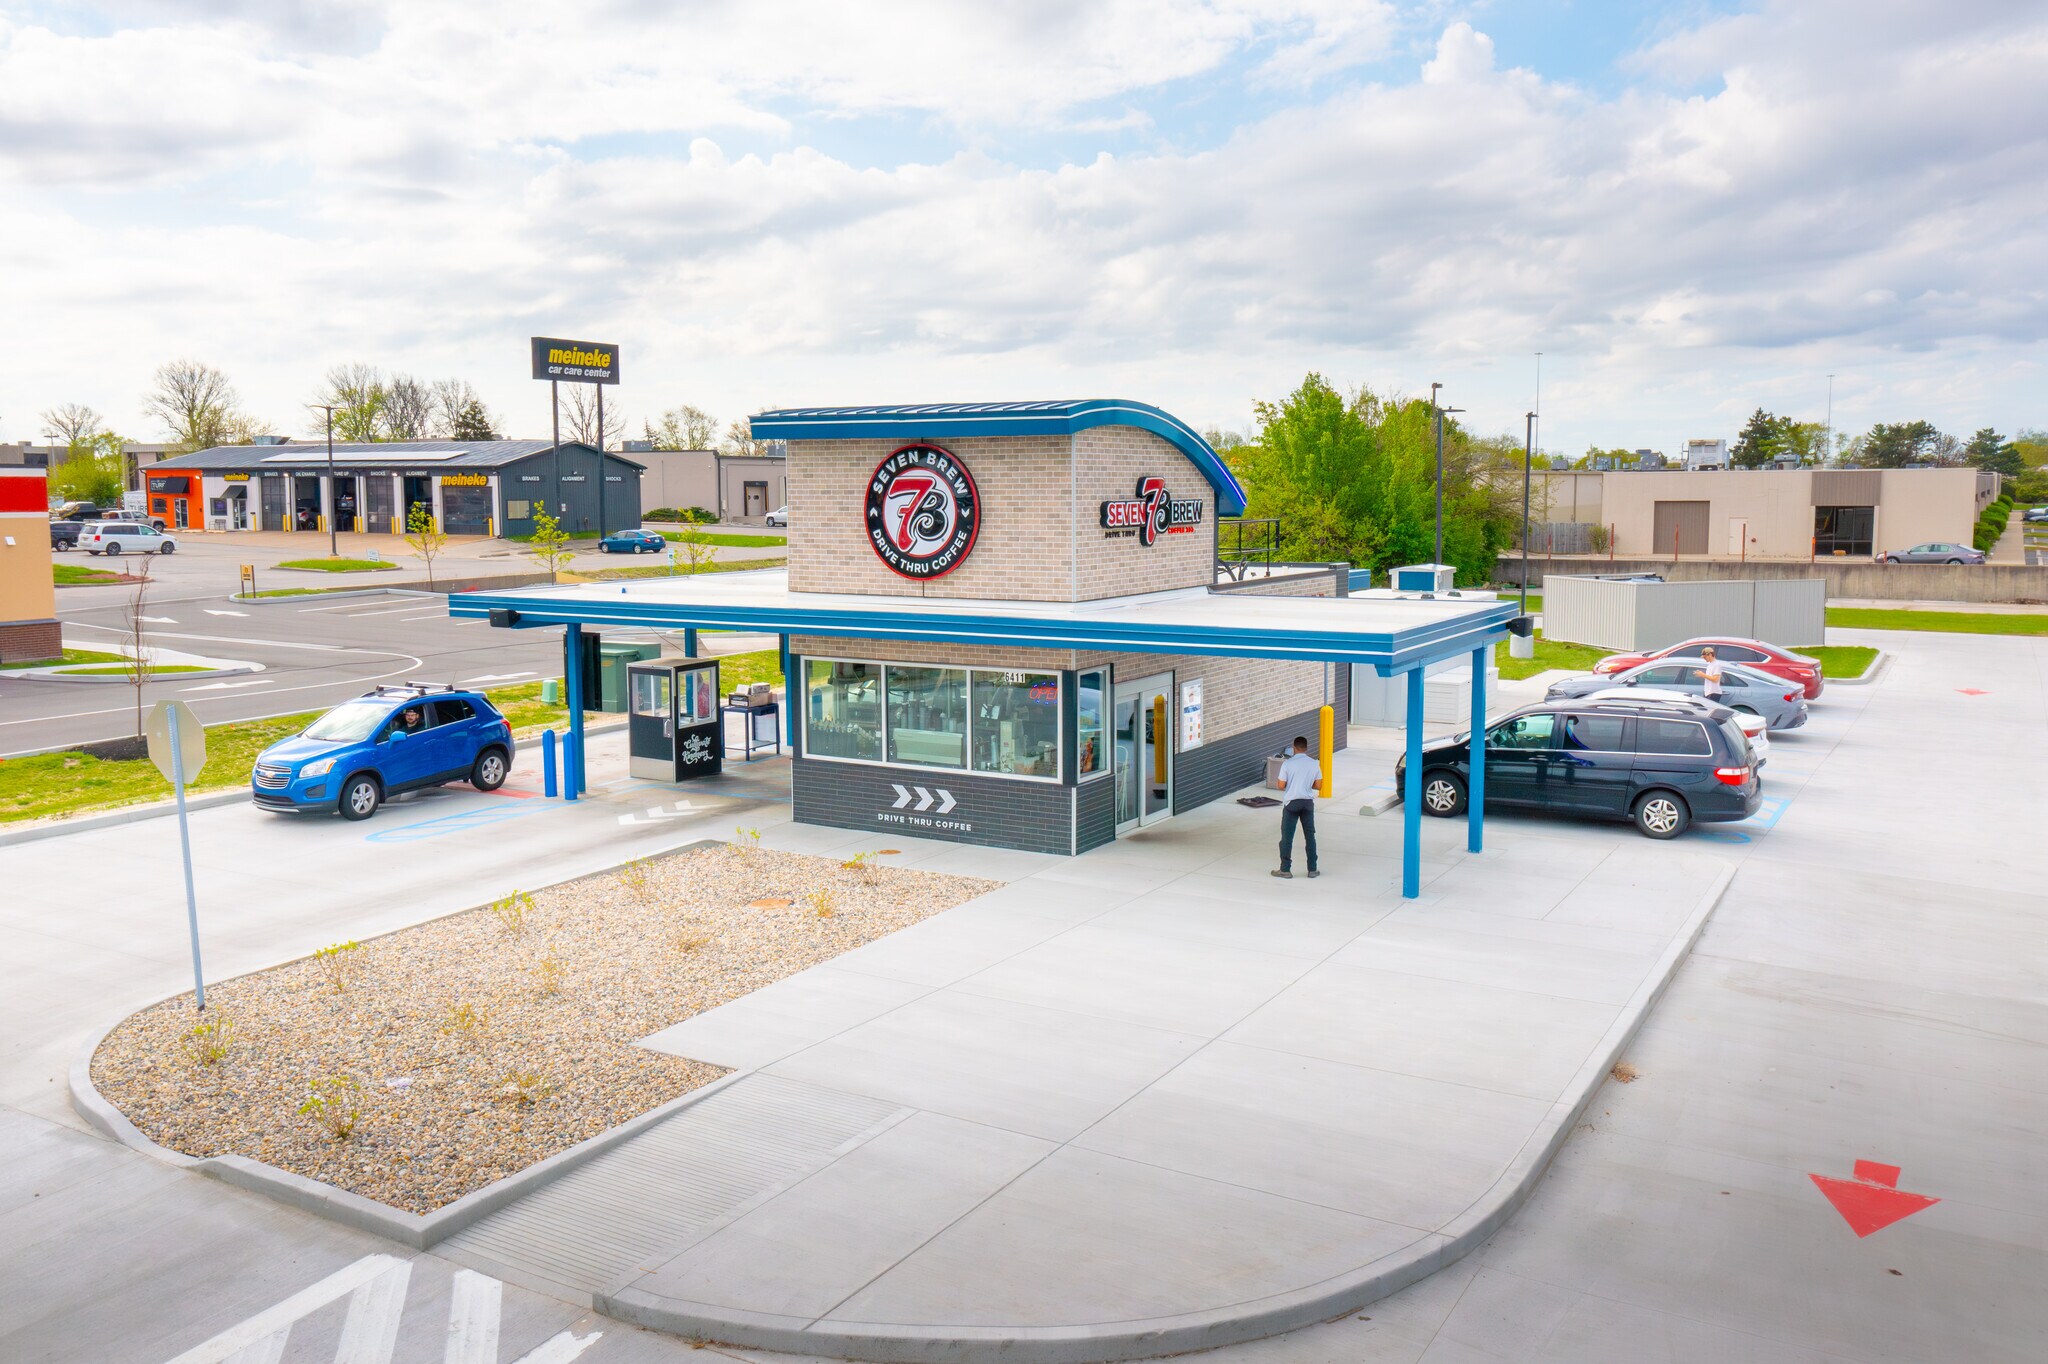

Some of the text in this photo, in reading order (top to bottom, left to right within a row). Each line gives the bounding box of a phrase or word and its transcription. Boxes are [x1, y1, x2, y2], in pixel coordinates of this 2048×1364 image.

[548, 346, 611, 367] meineke
[548, 365, 611, 378] car care center
[441, 472, 488, 486] meineke
[873, 450, 968, 495] SEVEN BREW
[1106, 502, 1147, 527] SEVEN
[1171, 500, 1203, 524] BREW
[873, 529, 968, 573] DRIVE THRU COFFEE
[1005, 671, 1025, 683] 6411
[877, 813, 972, 831] DRIVE THRU COFFEE
